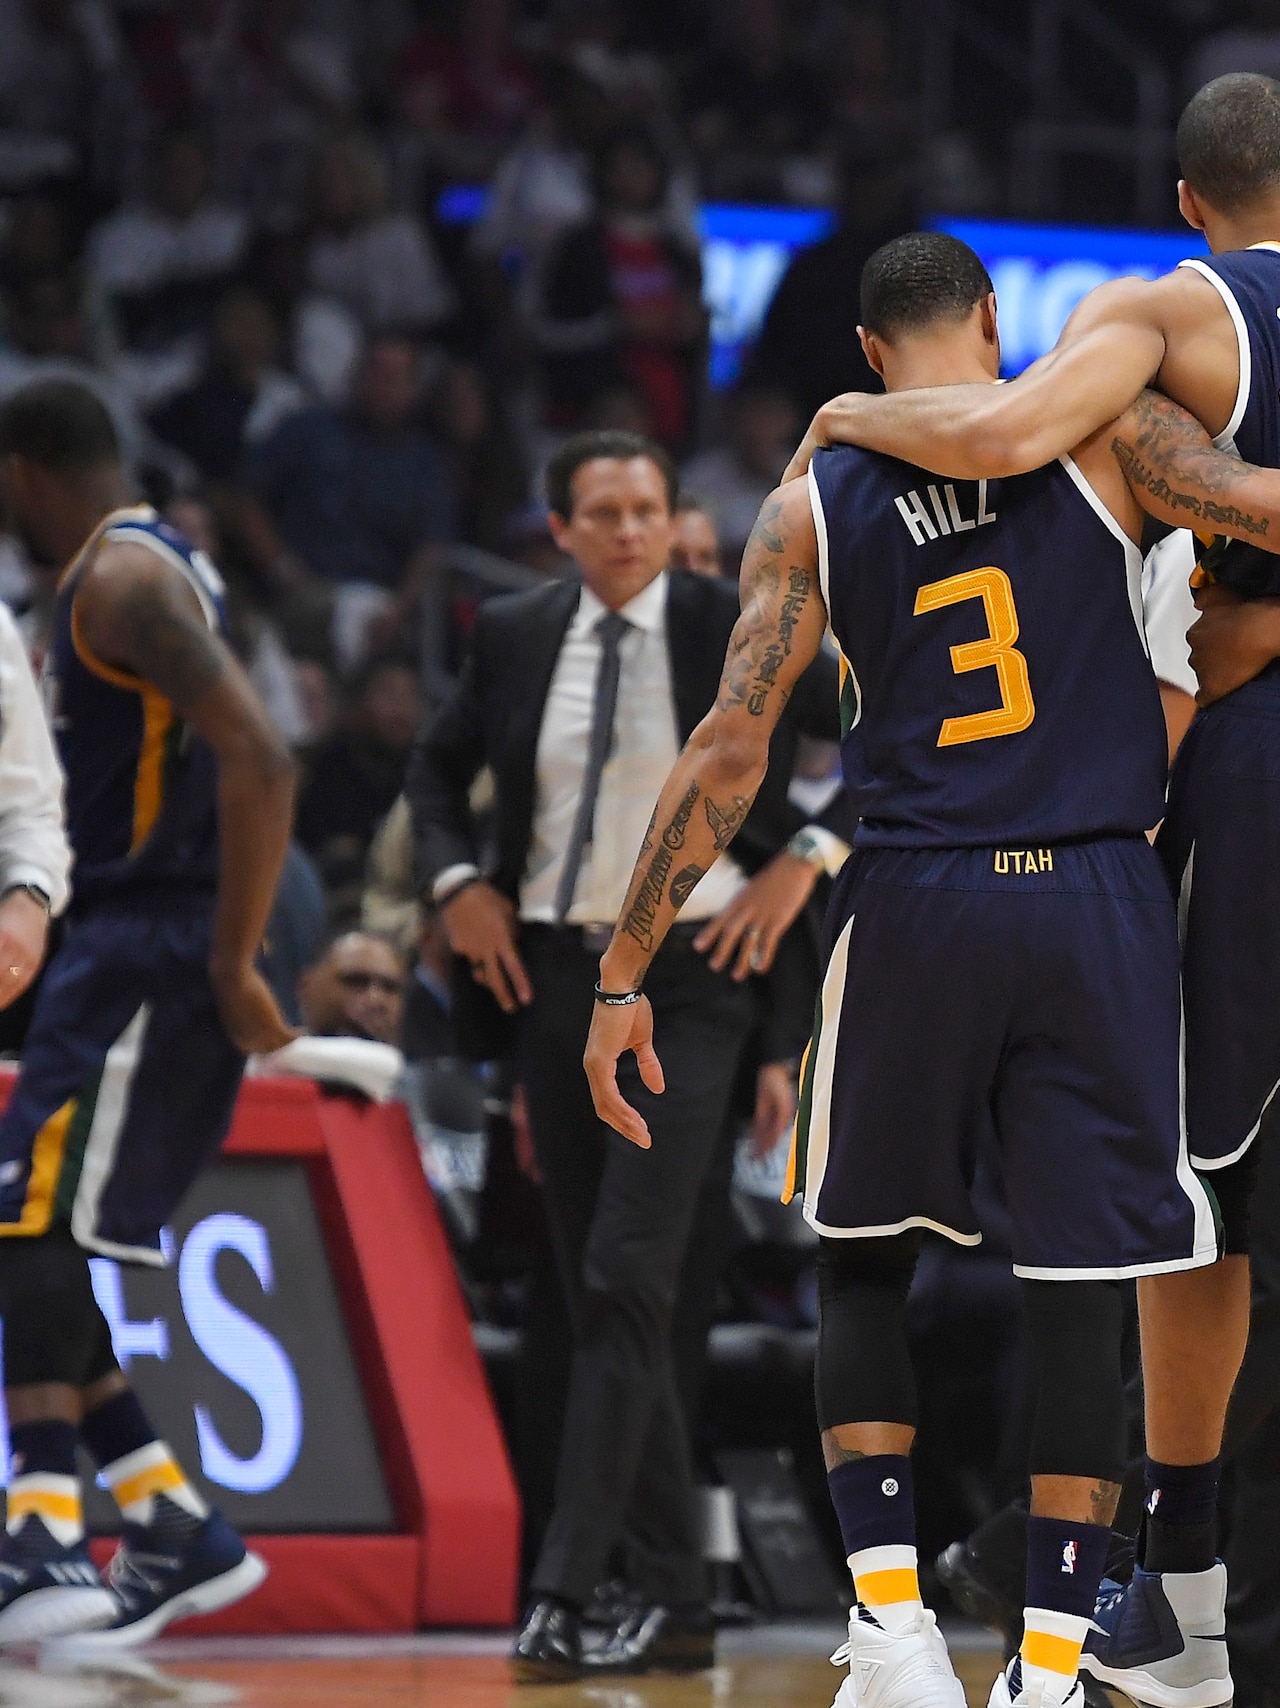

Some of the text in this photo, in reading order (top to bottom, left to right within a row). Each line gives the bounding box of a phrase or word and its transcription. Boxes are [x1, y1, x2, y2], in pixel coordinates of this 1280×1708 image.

[894, 479, 997, 546] HILL
[913, 566, 1035, 747] 3
[994, 848, 1054, 875] UTAH
